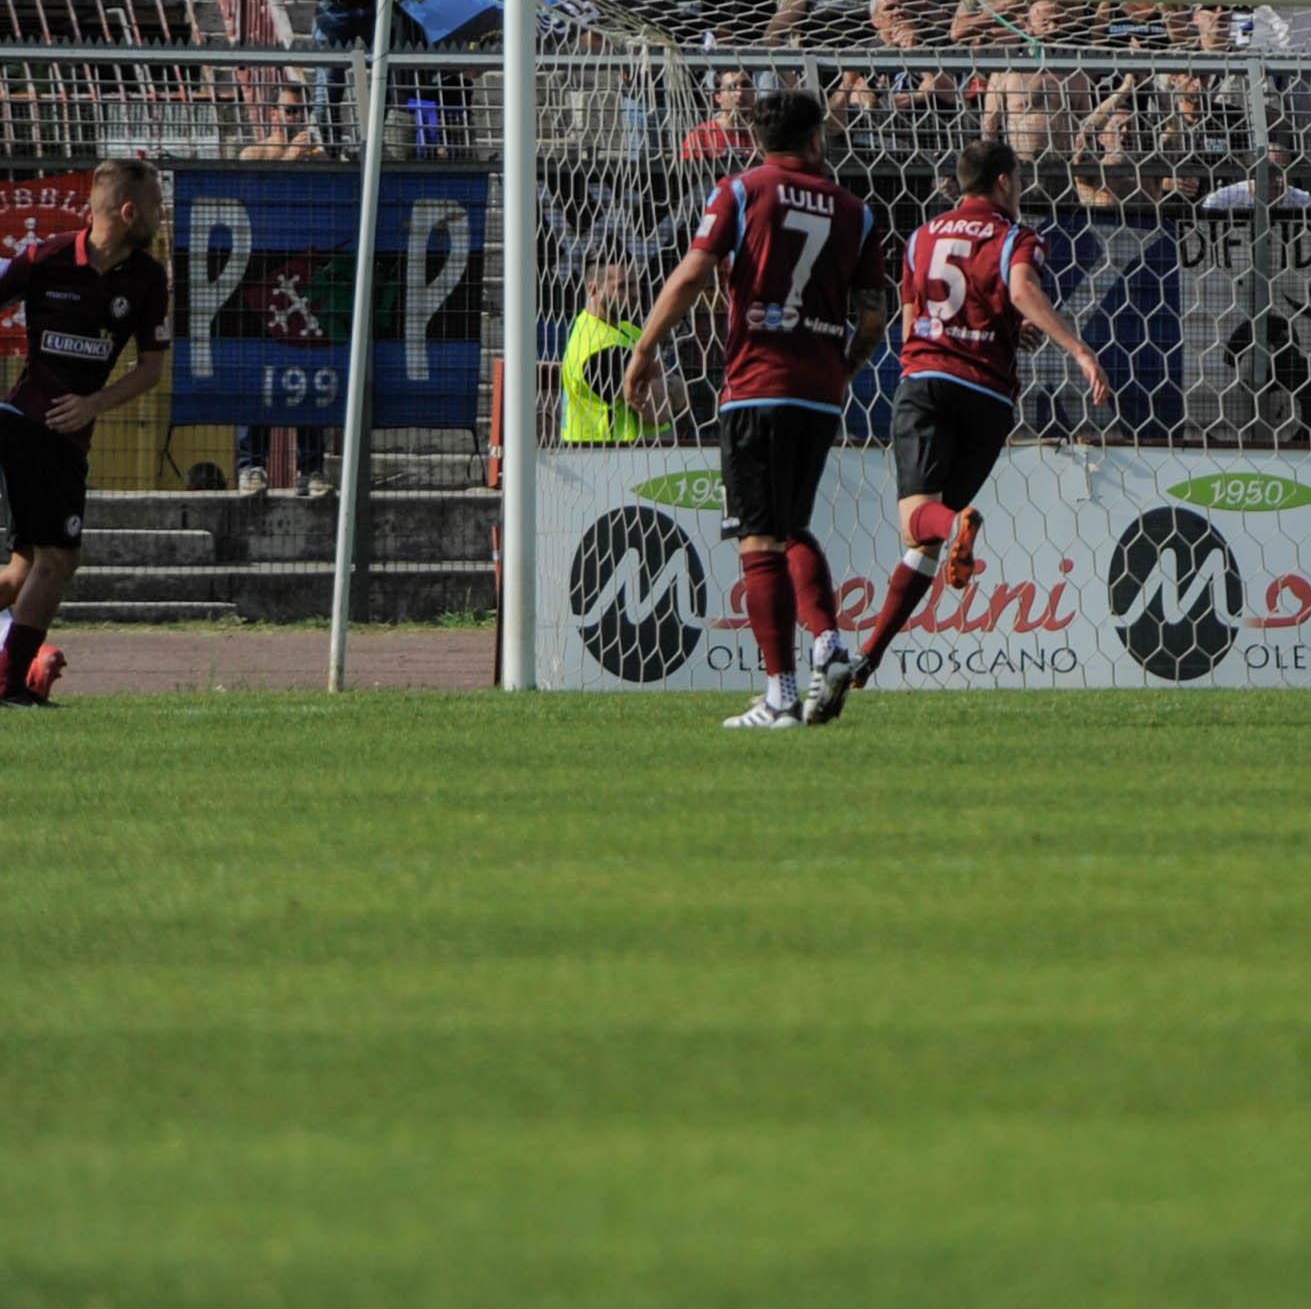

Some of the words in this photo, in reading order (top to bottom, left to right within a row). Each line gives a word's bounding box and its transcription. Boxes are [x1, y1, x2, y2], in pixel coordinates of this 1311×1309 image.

[777, 184, 835, 215] LULLI
[928, 219, 995, 238] VARGA
[783, 209, 832, 309] 7
[189, 197, 252, 377] P
[405, 198, 470, 381] P
[926, 238, 972, 321] 5
[263, 365, 340, 408] 199
[674, 477, 725, 504] 195
[1208, 479, 1285, 505] 1950
[892, 647, 1078, 674] TOSCANO
